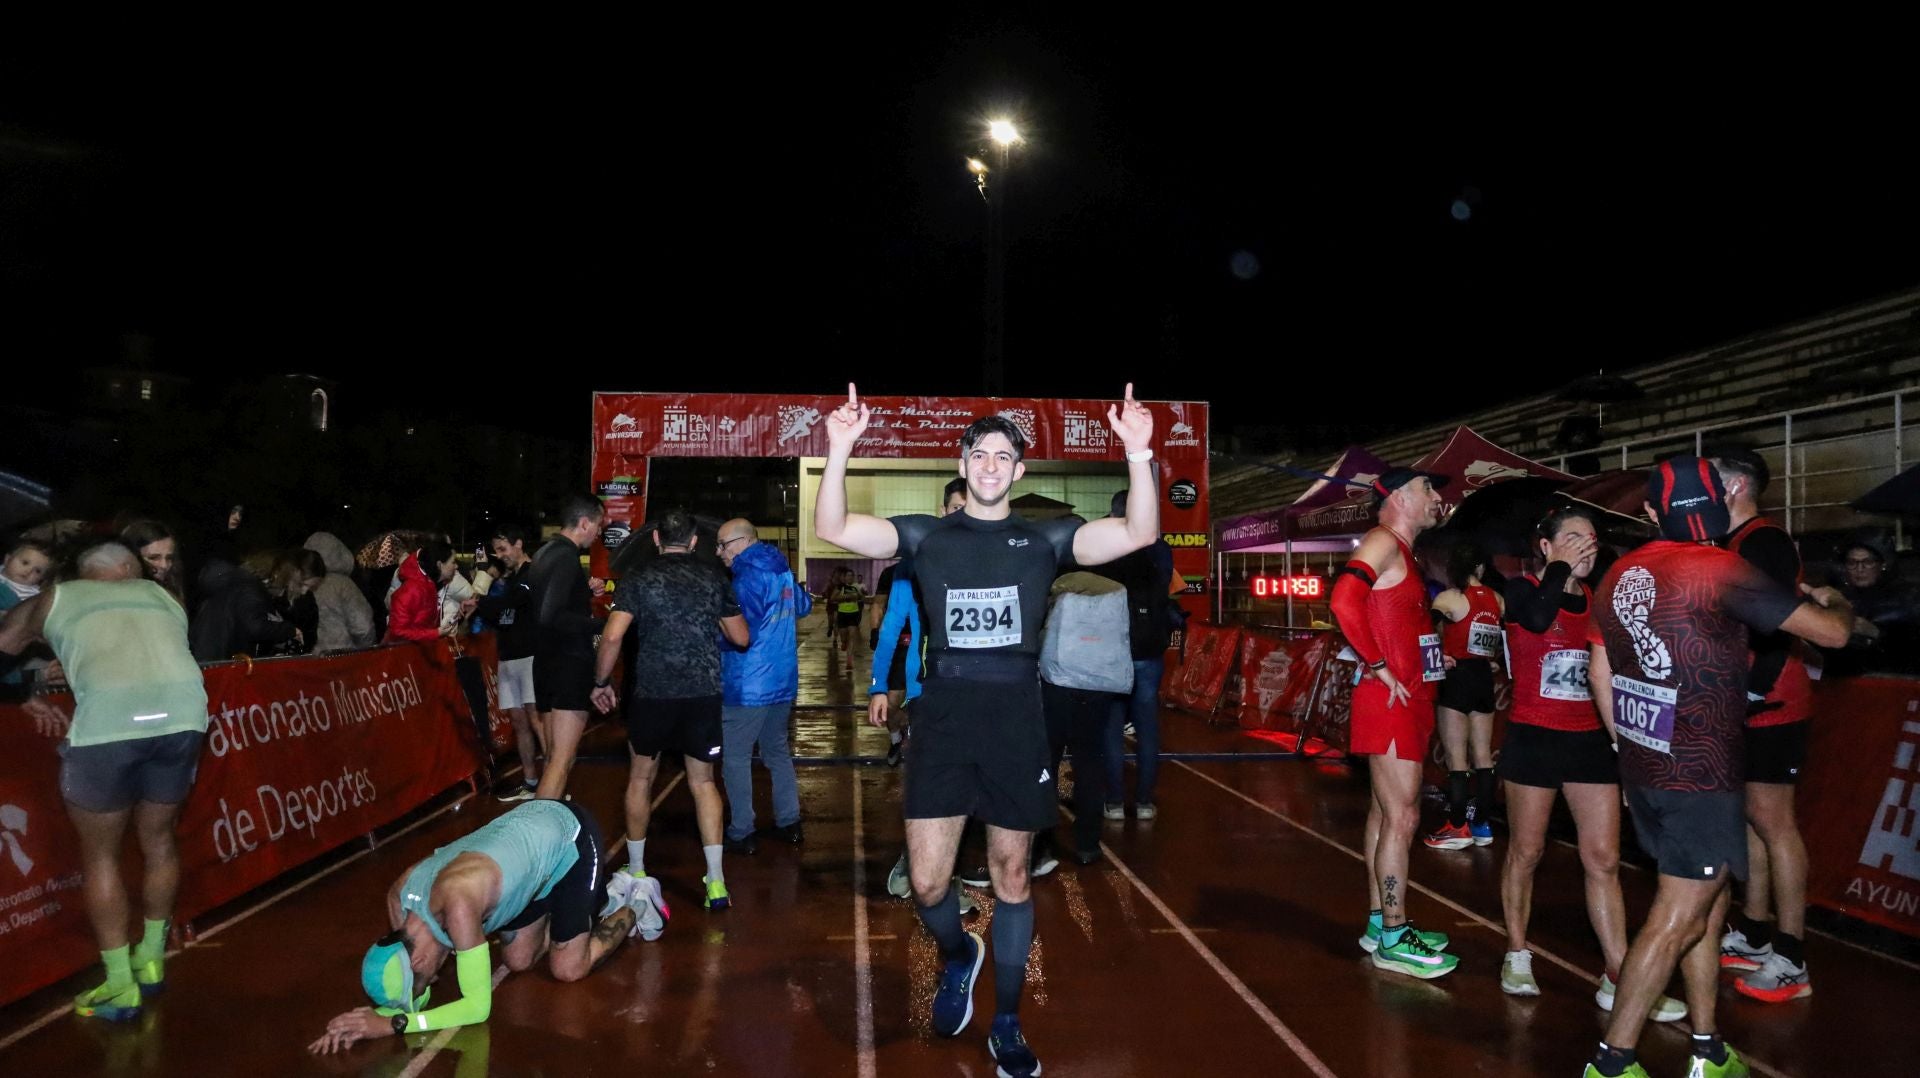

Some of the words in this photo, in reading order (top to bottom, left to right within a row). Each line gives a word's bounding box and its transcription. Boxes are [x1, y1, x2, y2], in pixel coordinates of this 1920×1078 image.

[899, 406, 974, 416] Maratón
[689, 414, 704, 423] PA
[689, 424, 711, 432] LEN
[890, 420, 911, 428] de
[1088, 420, 1102, 428] PA
[689, 433, 709, 441] CIA
[1088, 429, 1109, 438] LEN
[884, 437, 940, 448] Ayuntamiento
[943, 440, 953, 448] de
[1088, 438, 1106, 447] CIA
[1163, 533, 1208, 546] GADIS
[967, 590, 1002, 600] PALENCIA
[1618, 591, 1650, 607] TRAIL
[949, 605, 1014, 632] 2394
[1628, 681, 1656, 697] PALENCIA
[207, 690, 331, 757] atronato
[330, 664, 423, 727] Municipal
[1617, 694, 1662, 732] 1067
[213, 798, 258, 864] de
[256, 766, 377, 839] Deportes
